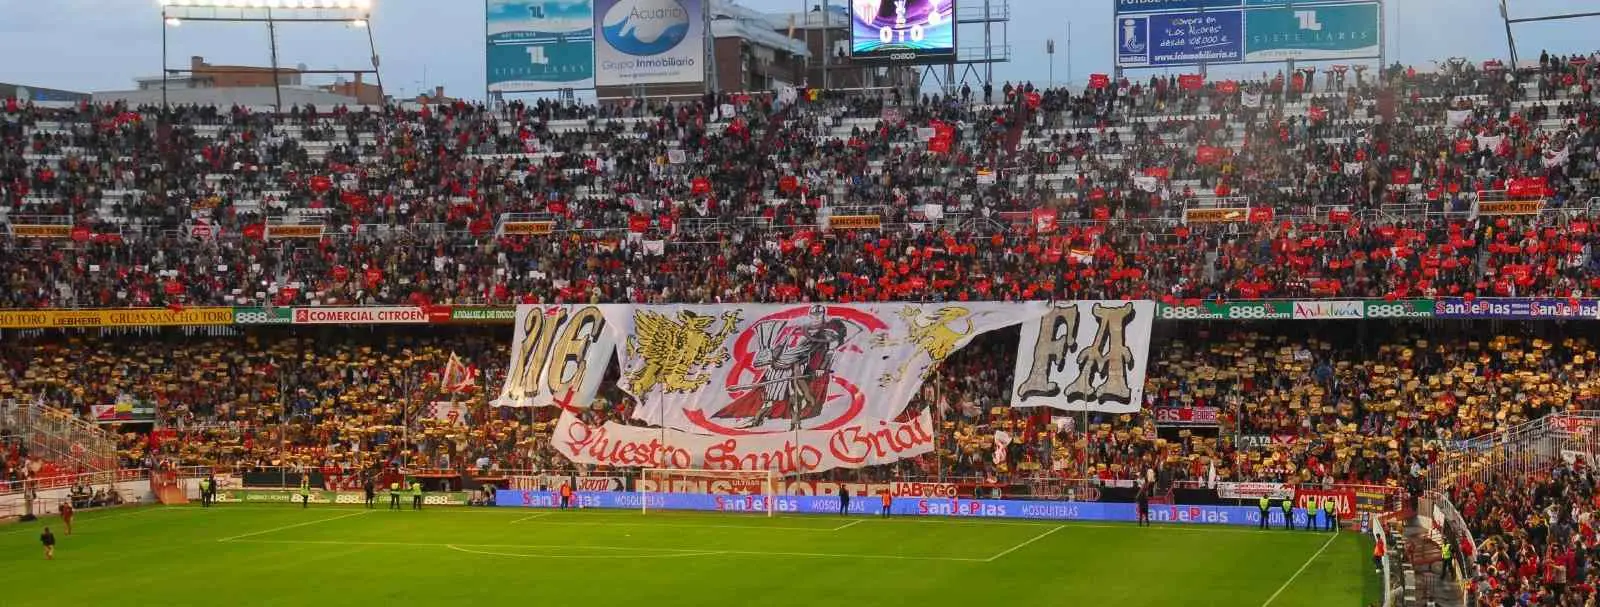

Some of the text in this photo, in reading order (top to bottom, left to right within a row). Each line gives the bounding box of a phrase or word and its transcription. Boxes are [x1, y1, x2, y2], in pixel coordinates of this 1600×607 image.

[630, 6, 681, 20] Acuario
[636, 56, 694, 67] Inmobiliario
[109, 312, 148, 323] GRUAS
[149, 311, 200, 323] SANCHO
[201, 310, 233, 322] TORO
[310, 311, 374, 321] COMERCIAL
[1163, 307, 1223, 319] 888.com
[1230, 306, 1290, 318] 888.com
[1367, 305, 1430, 317] 888.com
[17, 313, 46, 325] TORO
[53, 317, 101, 325] LIEBHERR
[236, 312, 290, 324] 888.com
[522, 492, 601, 507] SanJPlas
[919, 499, 1006, 516] SanJePlas
[1022, 503, 1079, 516] MOSQUITERAS
